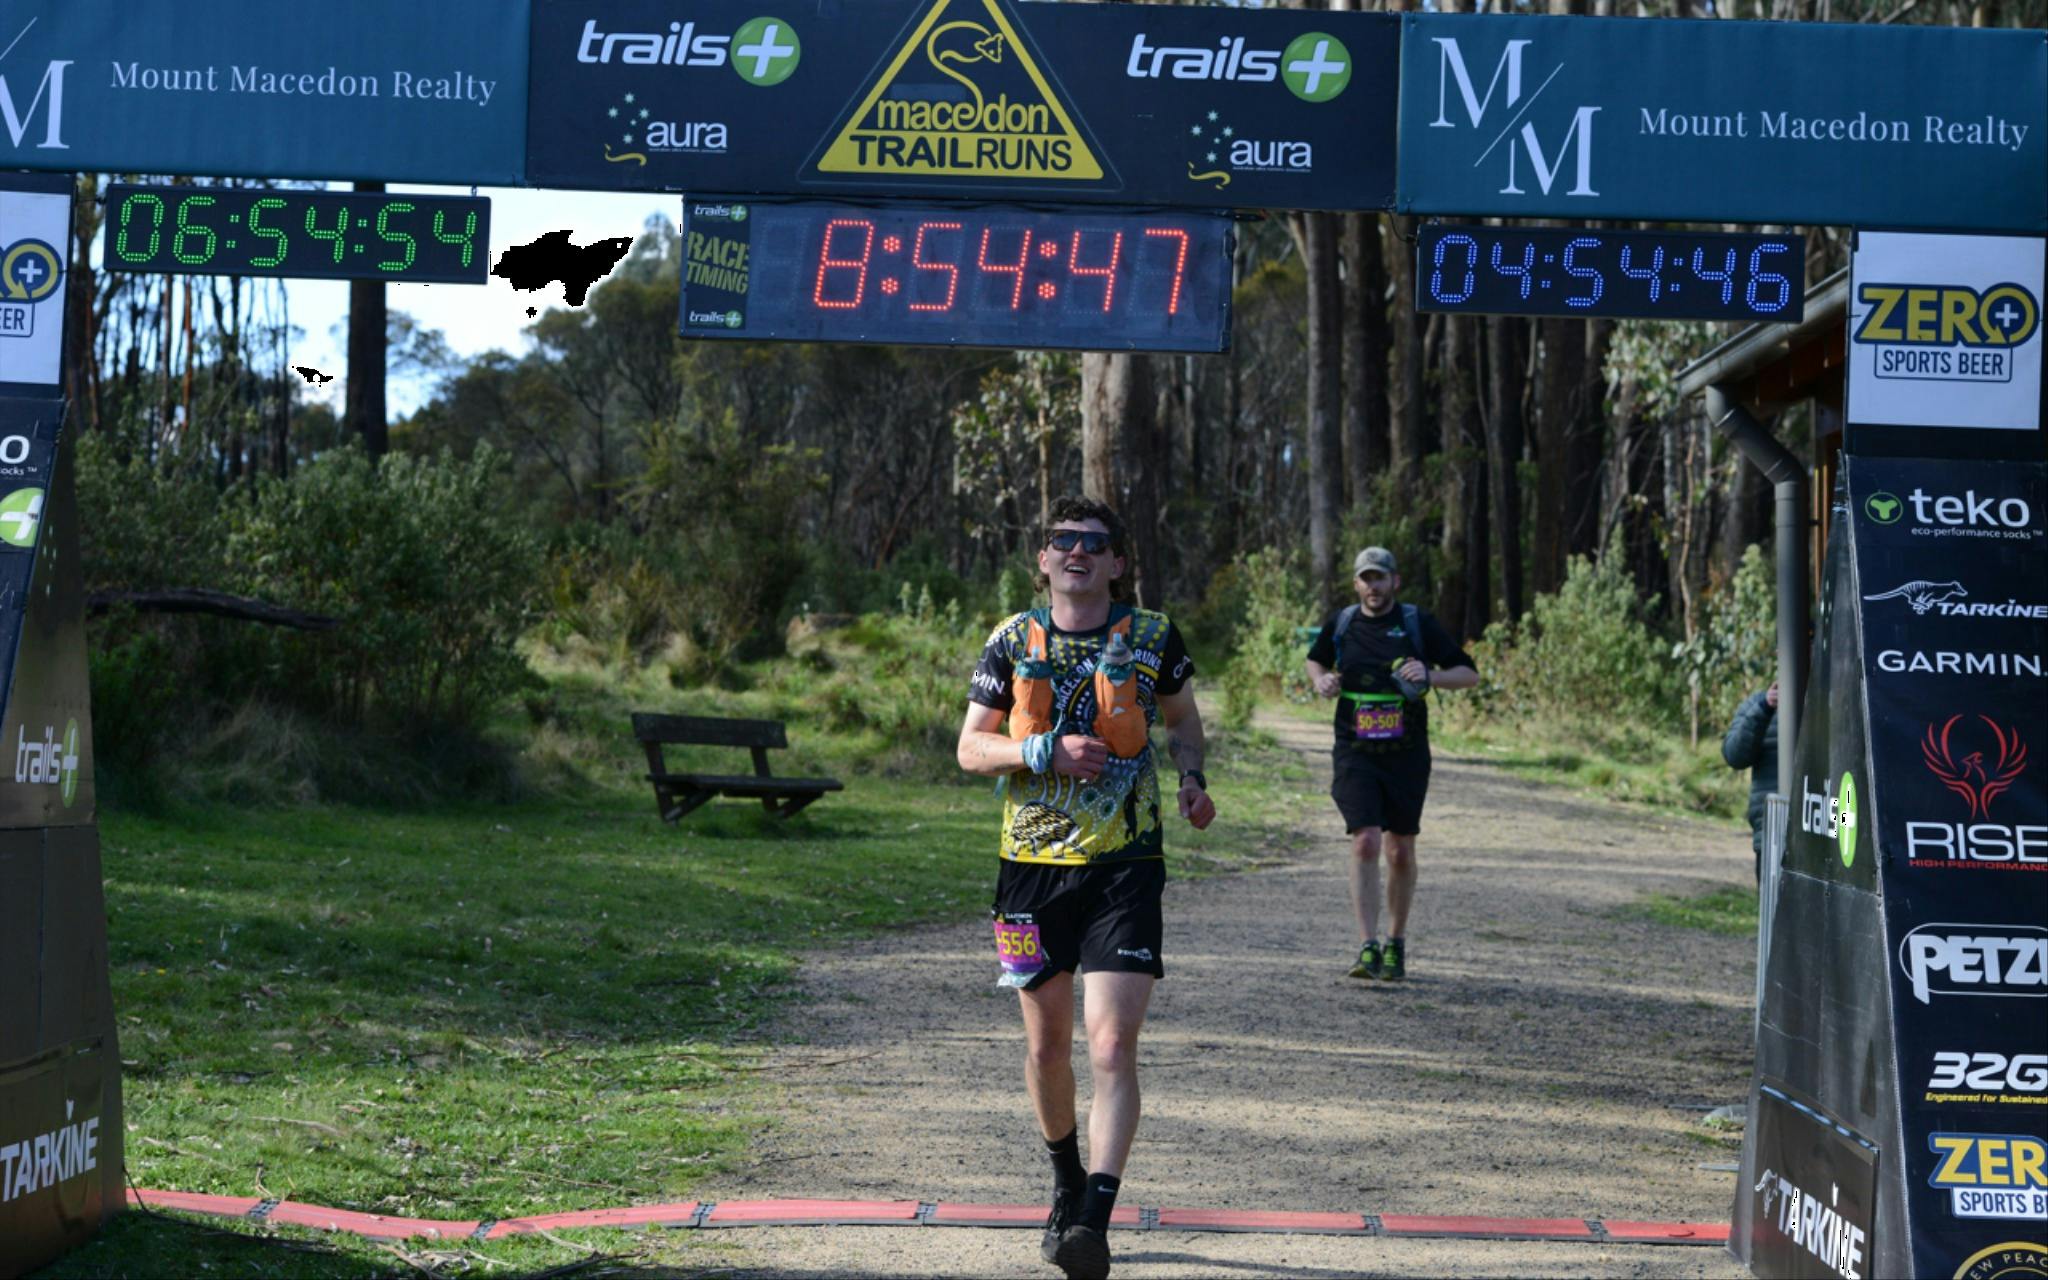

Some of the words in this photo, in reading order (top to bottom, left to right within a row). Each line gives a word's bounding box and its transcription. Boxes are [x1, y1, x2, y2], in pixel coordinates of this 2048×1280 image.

[112, 62, 217, 91] Mount
[230, 66, 378, 97] Macedon
[393, 72, 496, 106] Realty
[877, 93, 1049, 134] macedon
[1640, 108, 1748, 137] Mount
[1760, 112, 1910, 142] Macedon
[1925, 116, 2028, 151] Realty
[646, 121, 727, 149] aura
[1230, 139, 1312, 168] aura
[116, 193, 478, 272] 06:54:54
[687, 231, 750, 272] RACE
[686, 260, 749, 294] TIMING
[813, 219, 1190, 315] 8:54:47
[1431, 233, 1791, 313] 04:54:46
[1883, 350, 1952, 374] SPORTS
[1957, 352, 2004, 376] BEER
[1909, 488, 2030, 527] teko
[1911, 527, 2001, 539] eco-performance
[2003, 529, 2032, 540] socks
[1907, 822, 2048, 863] RISE
[1909, 859, 1944, 868] HIGH
[1925, 1092, 1981, 1103] Engineered
[1982, 1093, 1998, 1103] for
[1960, 1191, 2027, 1214] SPORTS
